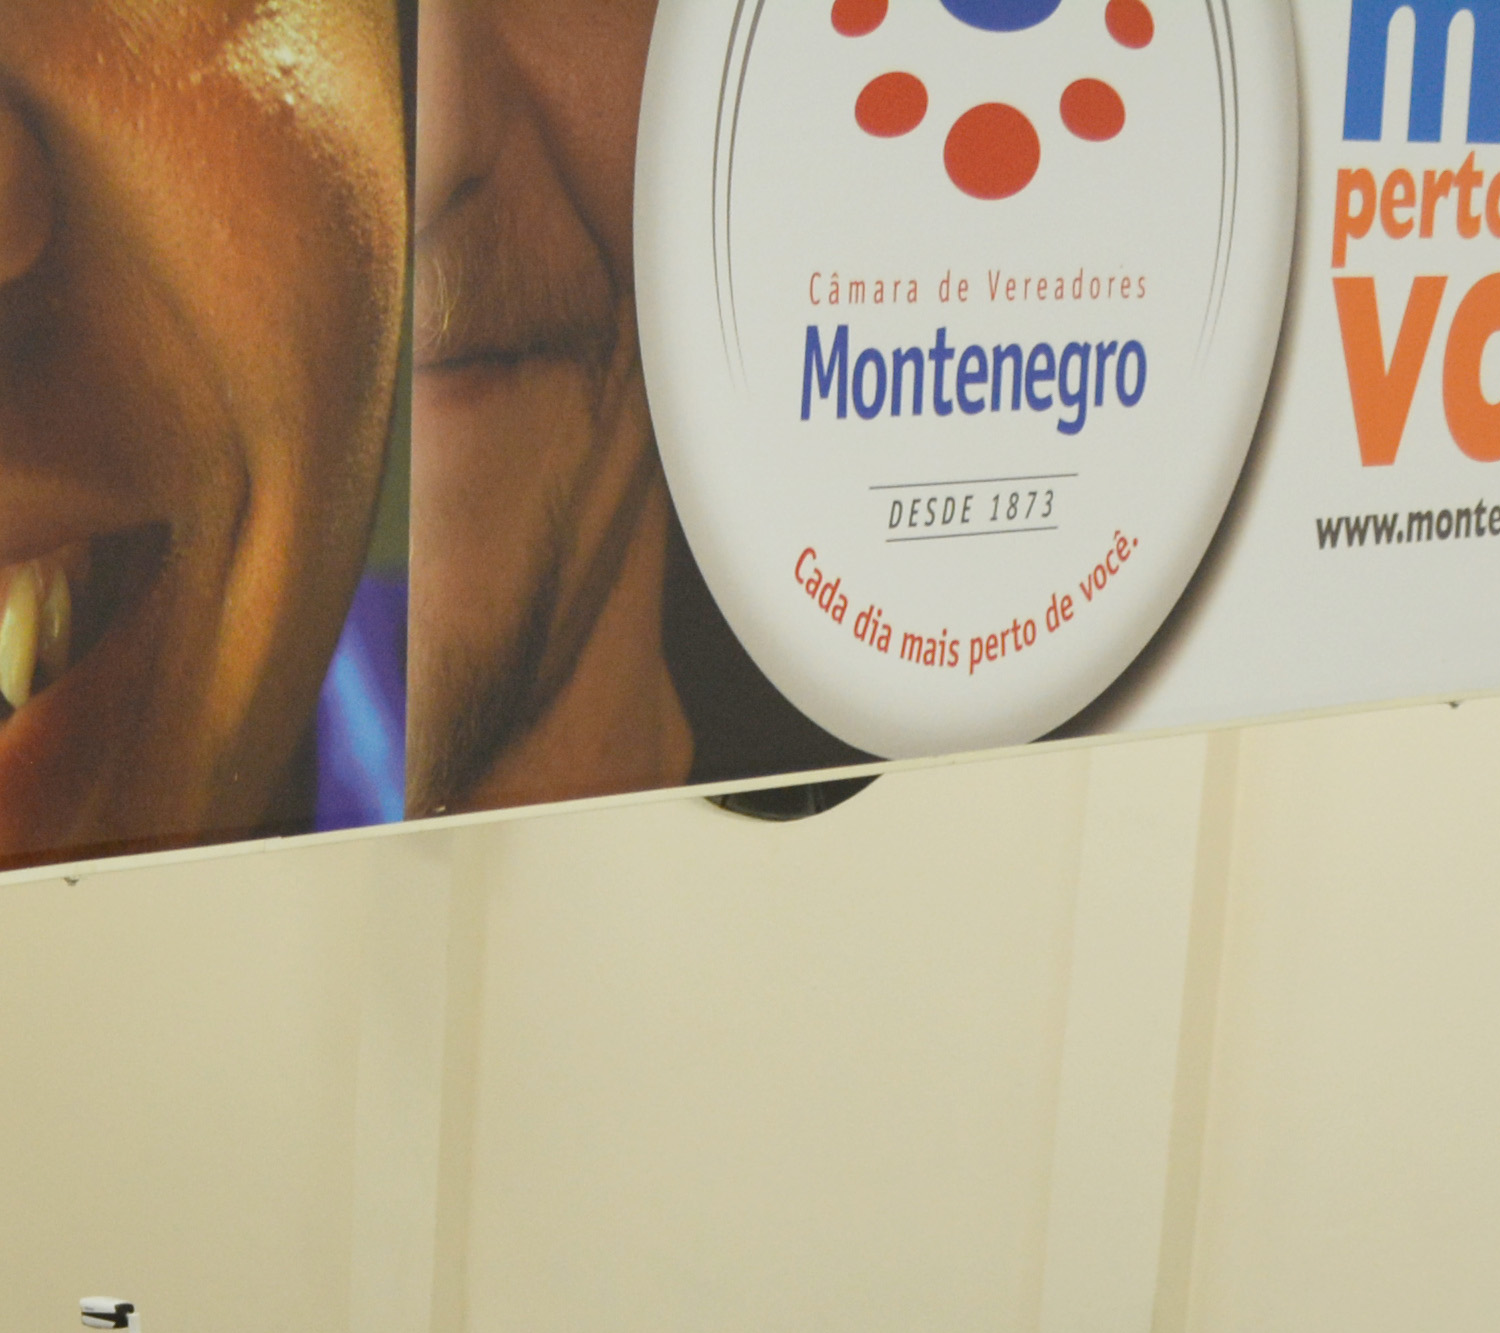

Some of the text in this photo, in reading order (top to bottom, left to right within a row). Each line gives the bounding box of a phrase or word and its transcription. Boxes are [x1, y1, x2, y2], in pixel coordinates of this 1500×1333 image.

[809, 268, 1147, 305] Câmara de Vereadores
[800, 324, 1147, 435] Montenegro
[889, 490, 1054, 529] DESDE 1873
[794, 530, 1138, 675] Cada dia mais perto de você.
